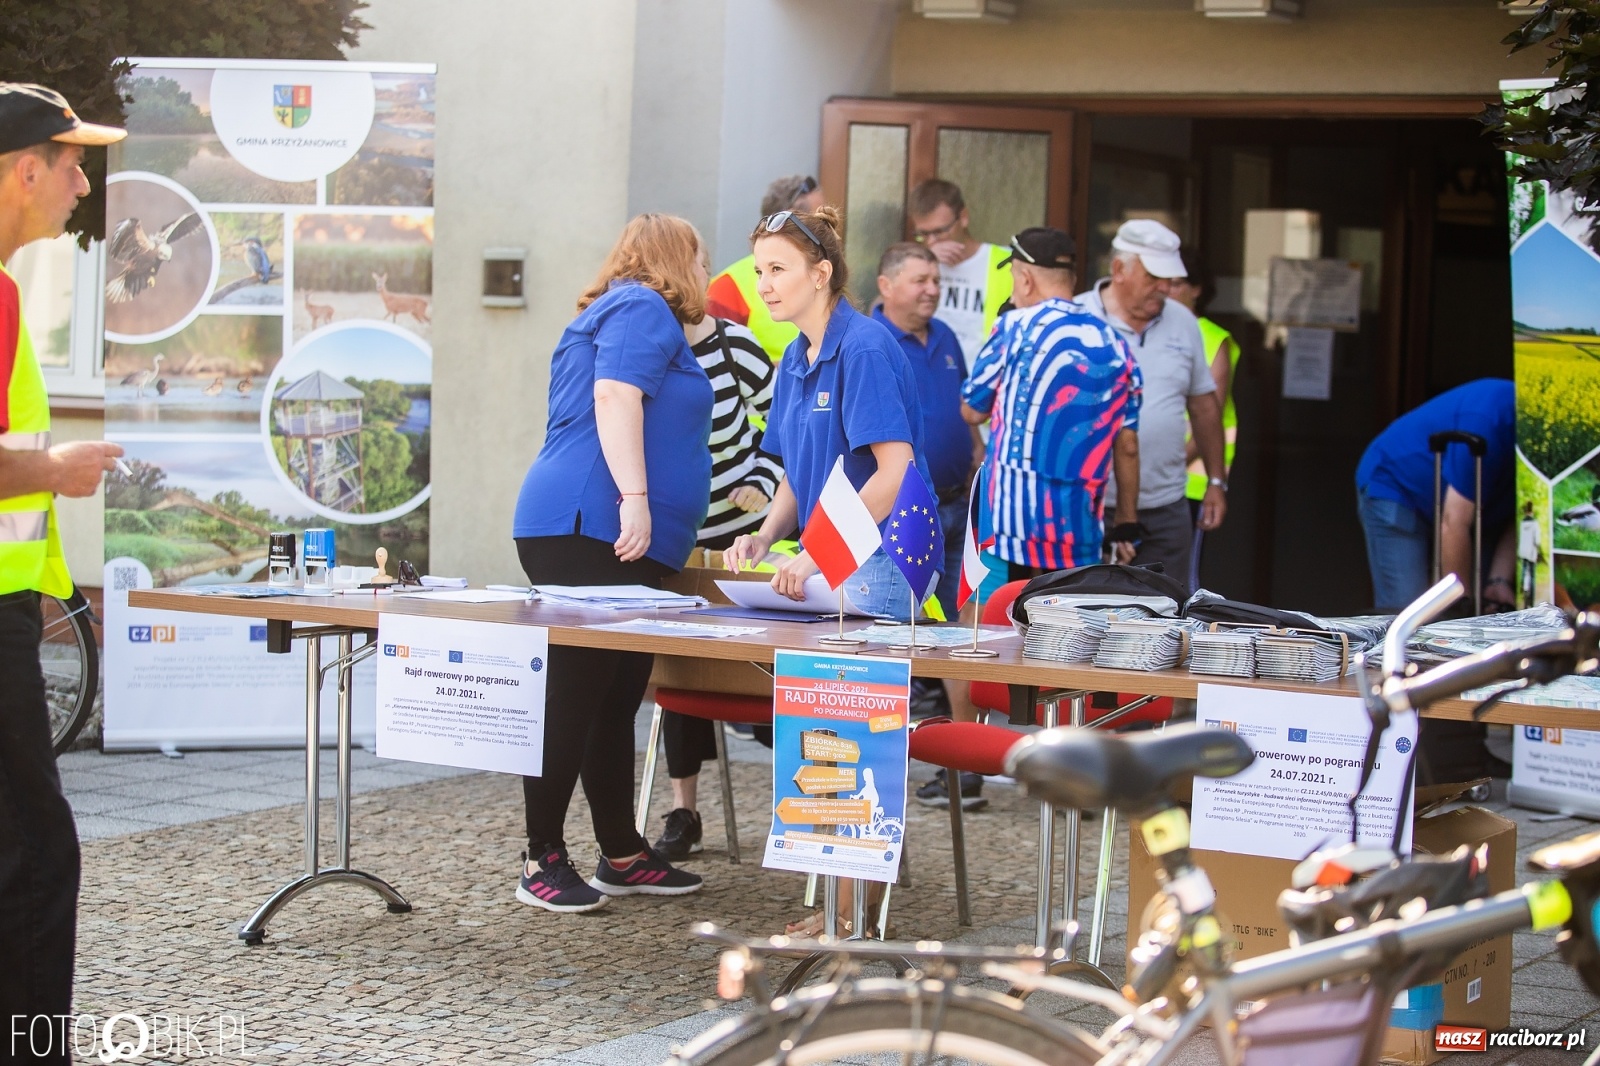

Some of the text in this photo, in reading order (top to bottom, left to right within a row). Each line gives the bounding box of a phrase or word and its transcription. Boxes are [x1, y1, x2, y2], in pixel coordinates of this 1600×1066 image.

[236, 137, 347, 147] GMINA KRZYŻANOWICE
[832, 664, 868, 672] KRZYŻANOWICE
[405, 666, 519, 687] Rajd rowerowy po pograniczu
[436, 686, 485, 700] 24.07.2021 r.
[814, 682, 868, 693] 24 LIPIEC 2021
[785, 690, 897, 710] RAJD ROWEROWY
[825, 709, 869, 718] POGRANICZU
[805, 736, 839, 747] ZBIÓRKA:
[805, 749, 831, 757] START:
[1255, 750, 1381, 771] rowerowy po pograniu
[1270, 769, 1336, 785] 24.07.2021 r.
[1254, 927, 1277, 937] "BIKE"
[1445, 969, 1457, 984] CTN
